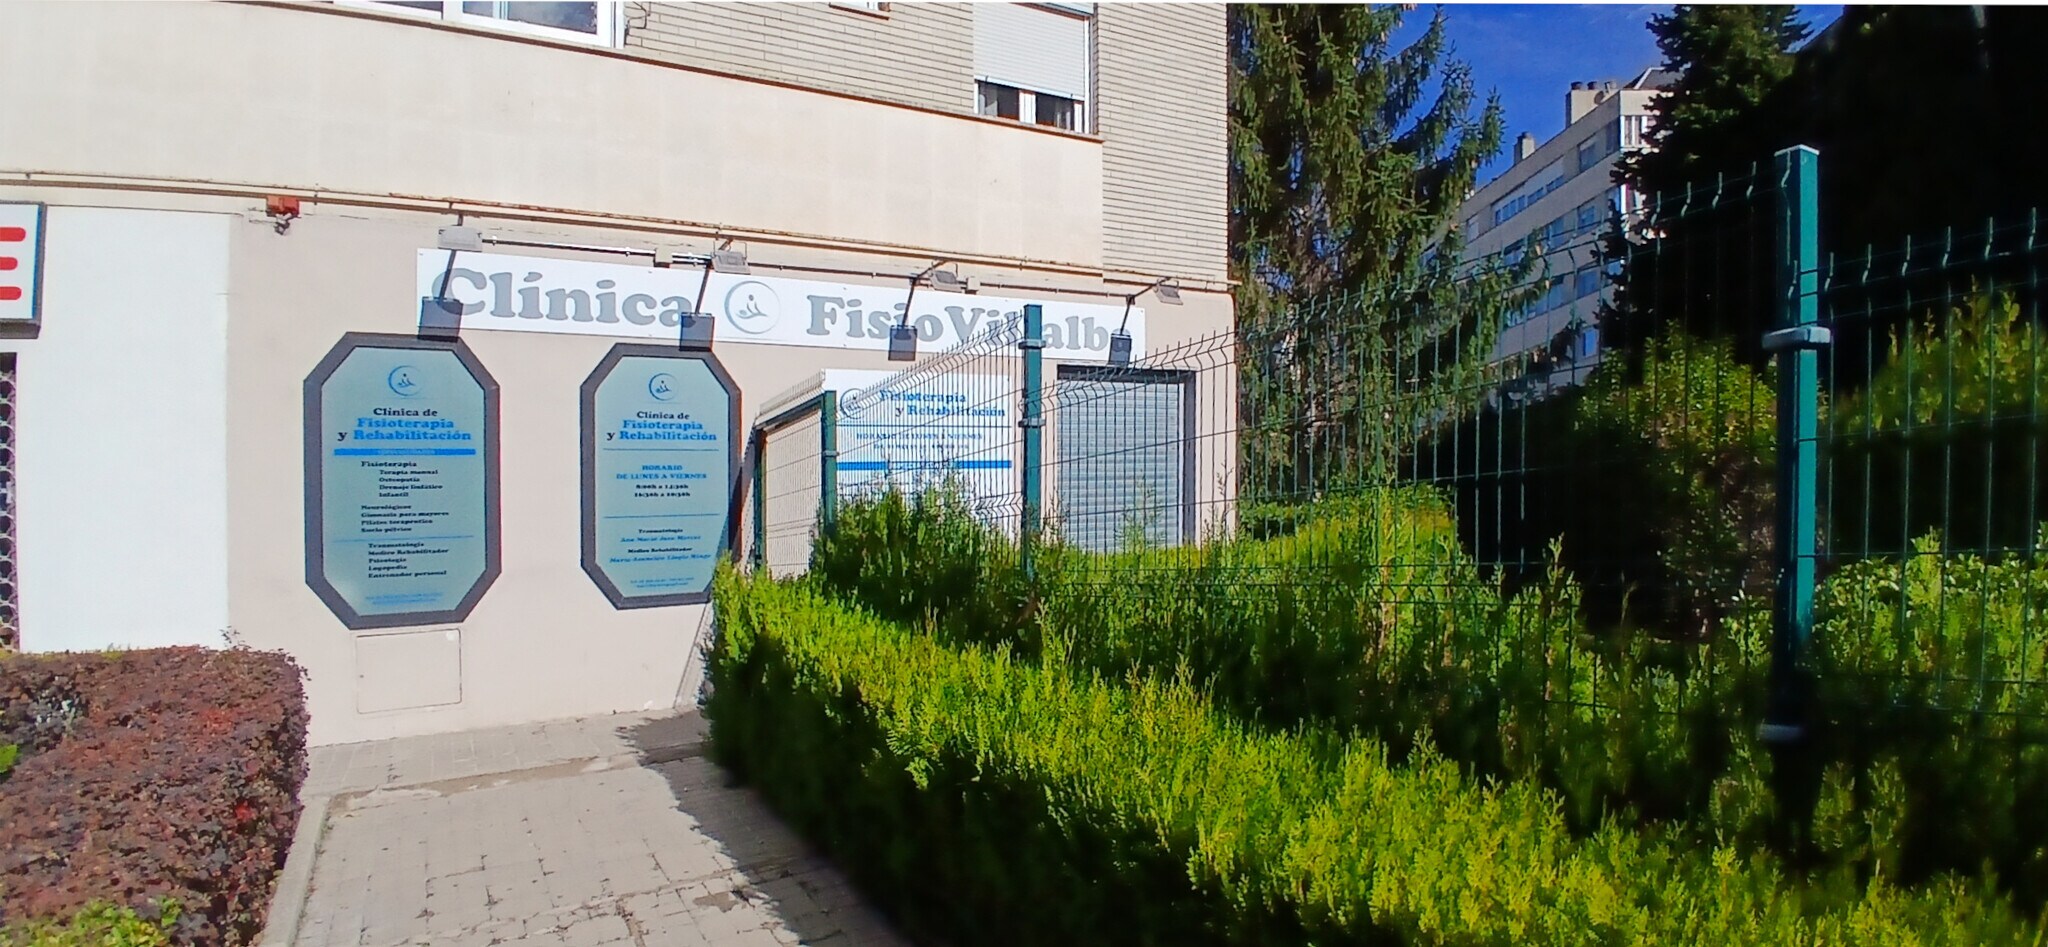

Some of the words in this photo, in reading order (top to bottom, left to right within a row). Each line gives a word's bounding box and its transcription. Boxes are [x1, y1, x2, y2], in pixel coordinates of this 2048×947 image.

[432, 268, 696, 327] Clínica
[807, 295, 1131, 351] FisioVilalba
[423, 408, 438, 416] de
[908, 405, 1005, 416] Rehabilitación
[358, 418, 454, 430] Fisioterapia
[623, 420, 703, 431] Fisioterapia
[338, 432, 348, 441] y
[354, 430, 472, 440] Rehabilitación
[606, 432, 616, 440] y
[620, 430, 717, 440] Rehabilitación
